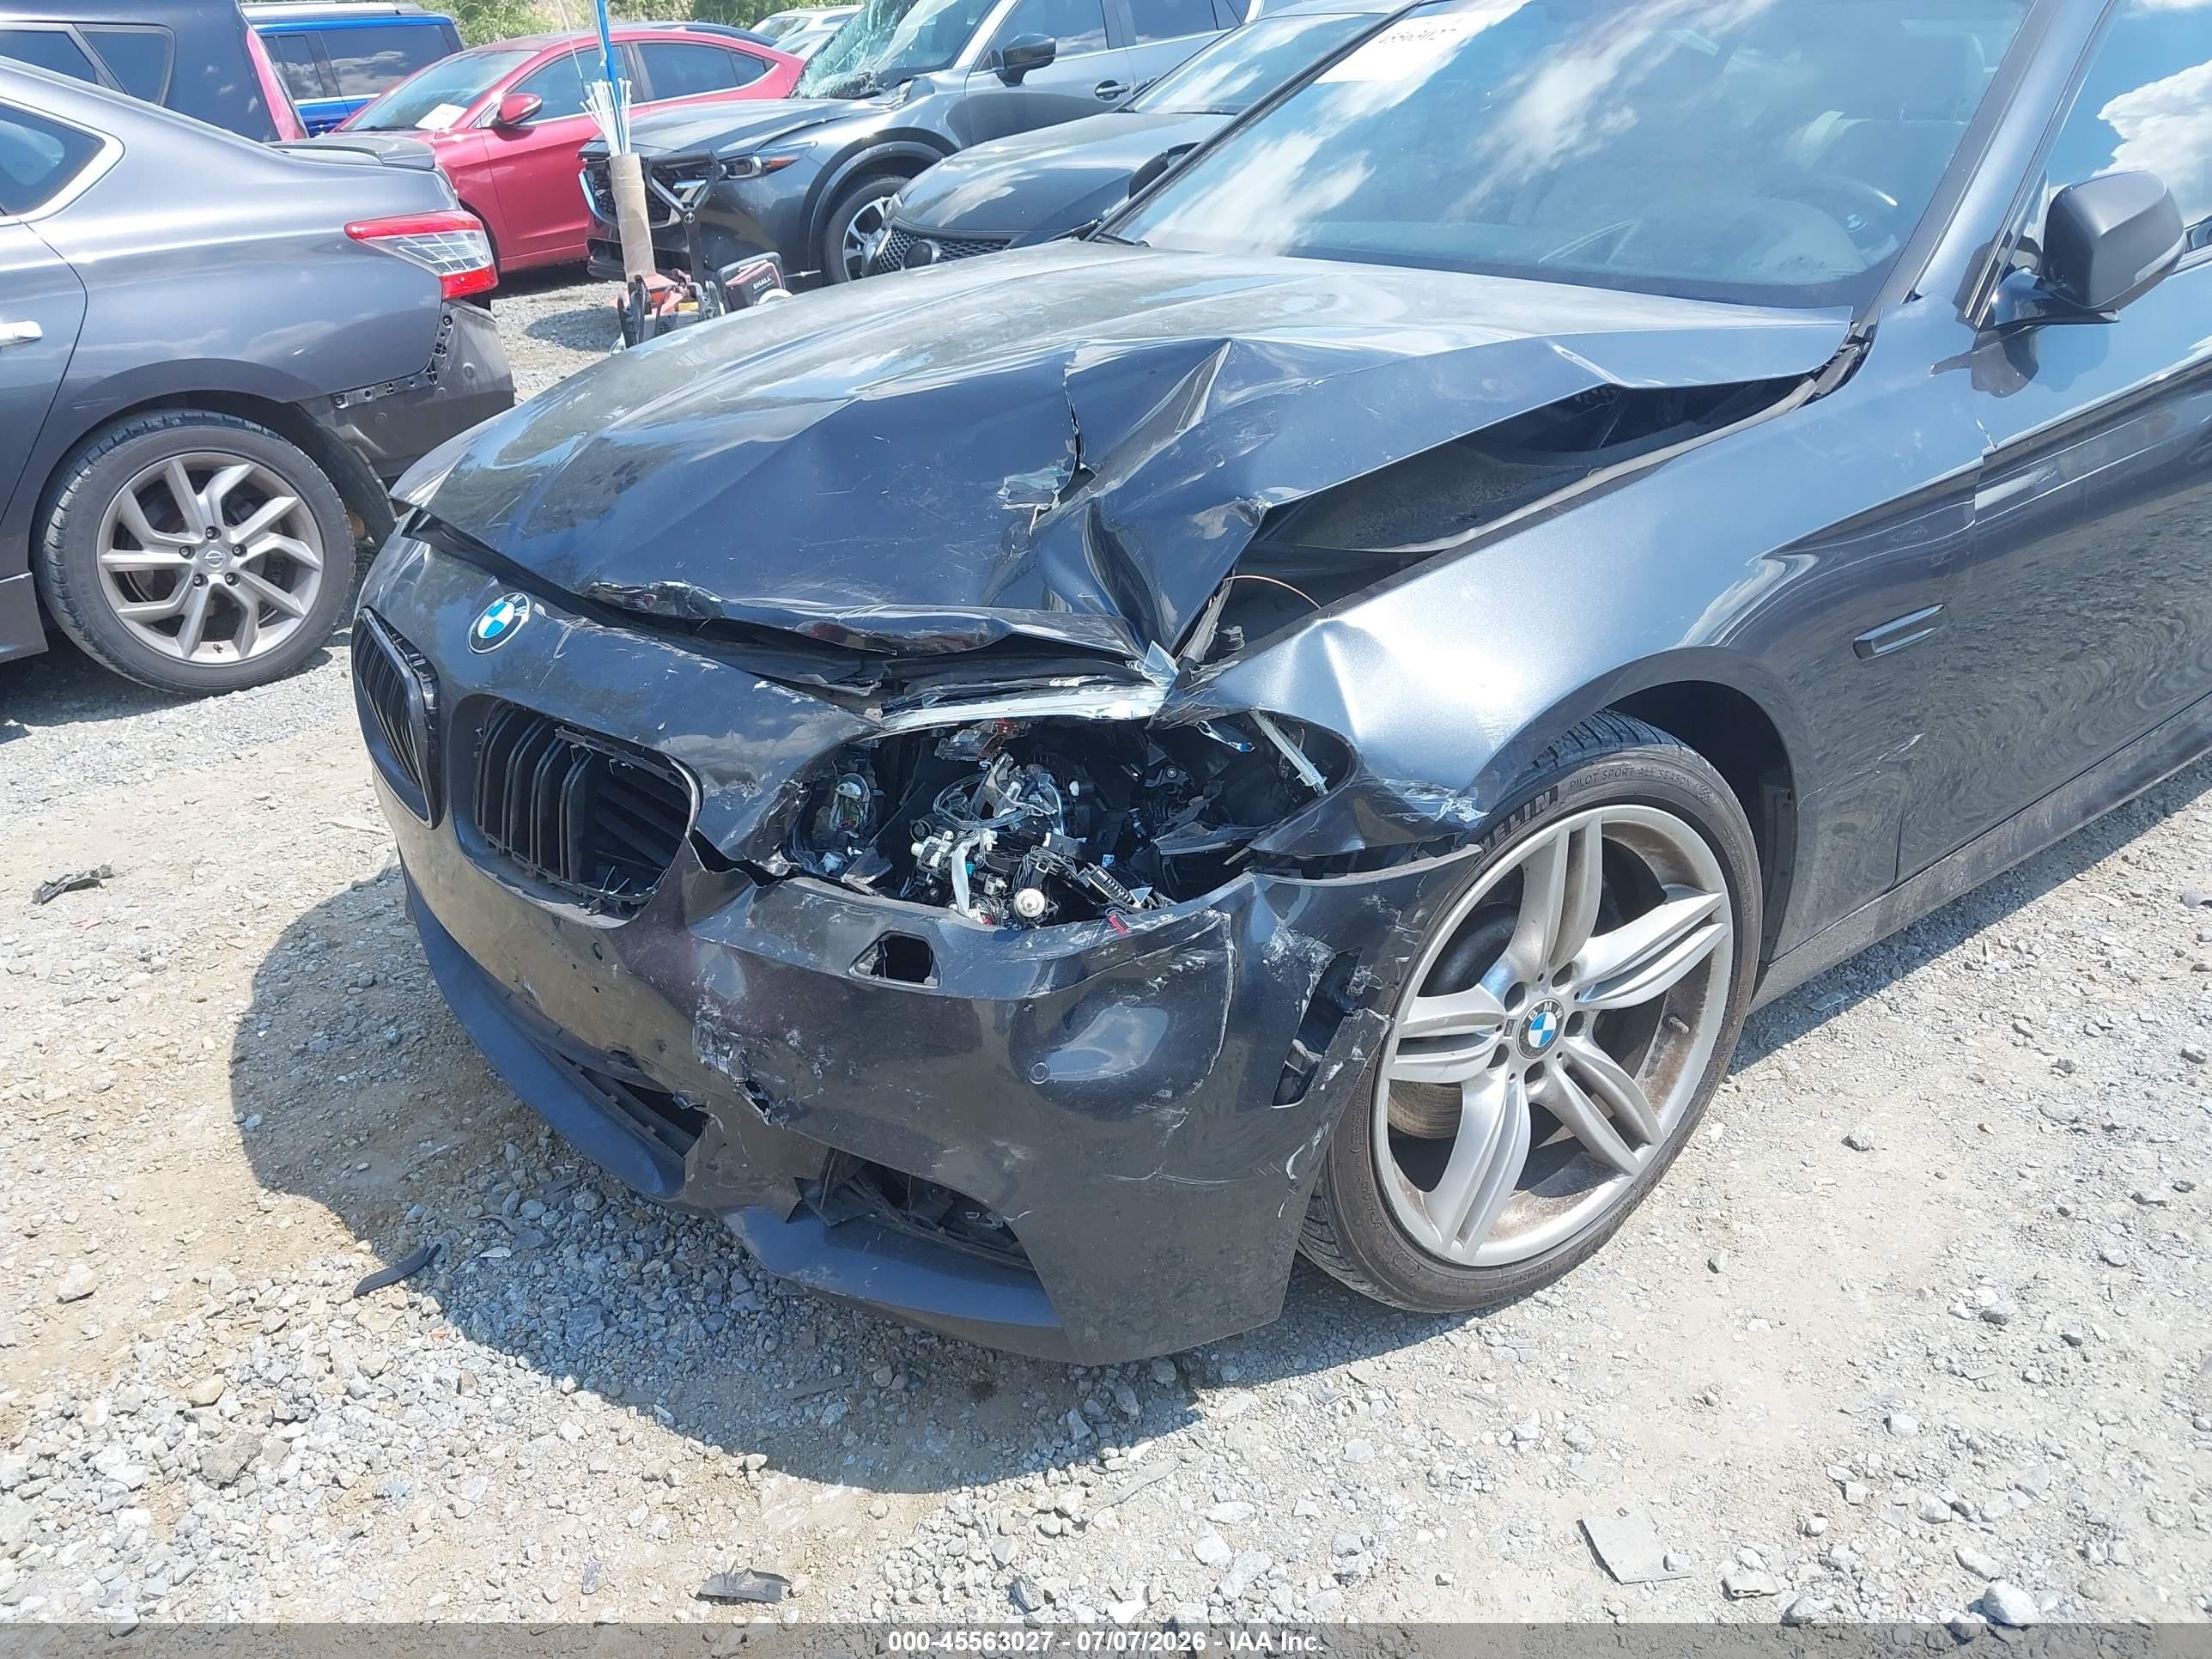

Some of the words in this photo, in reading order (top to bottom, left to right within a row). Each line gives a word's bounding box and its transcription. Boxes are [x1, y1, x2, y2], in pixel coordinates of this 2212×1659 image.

[1569, 772, 1599, 791] PILOT
[1601, 767, 1635, 781] SPORT
[1638, 767, 1656, 777] ALL
[1658, 769, 1692, 787] SEASON
[1528, 1001, 1563, 1021] BMW
